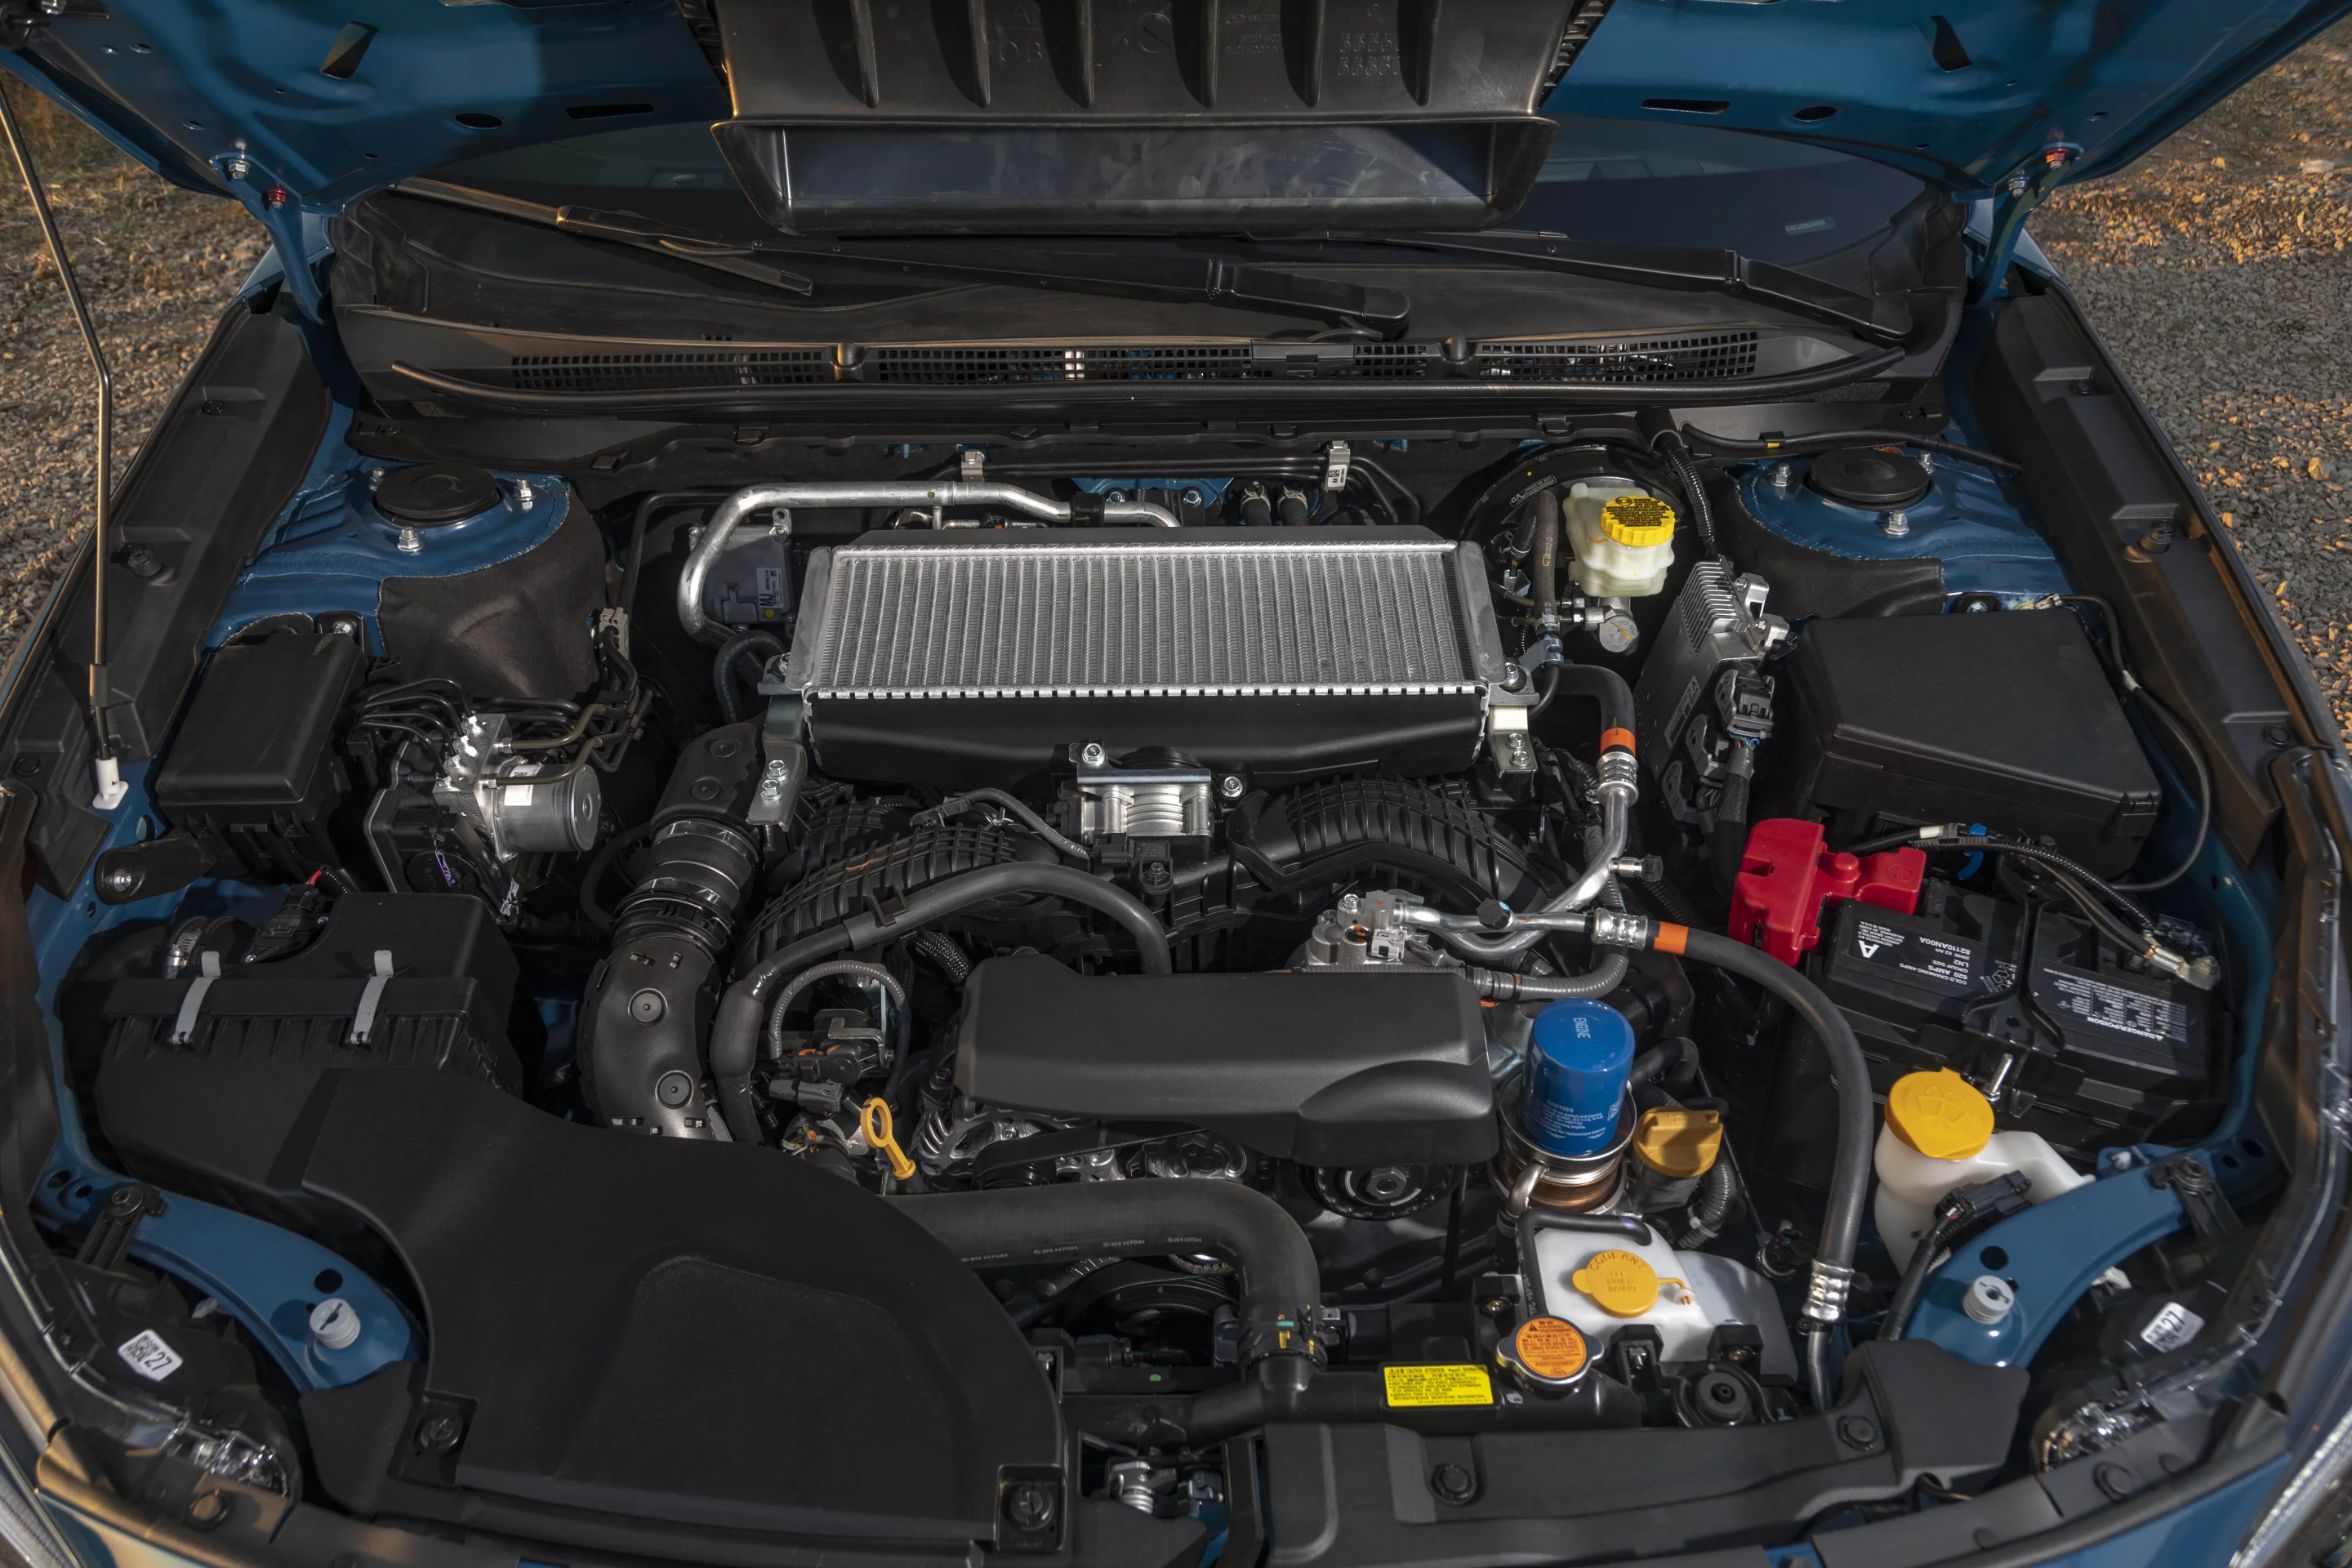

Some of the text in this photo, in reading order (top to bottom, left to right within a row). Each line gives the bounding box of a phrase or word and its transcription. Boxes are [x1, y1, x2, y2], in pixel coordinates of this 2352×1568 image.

[760, 594, 773, 606] MJ
[1918, 937, 1971, 955] 82110AN00A
[1927, 964, 1967, 980] 620 AMPS
[1946, 964, 1968, 973] GROUP
[1953, 959, 1969, 968] LN2
[1899, 963, 1967, 985] COLD CRANKING AMPS
[1574, 1018, 1591, 1038] ENGINE
[1547, 1099, 1574, 1112] CAUTION
[2162, 1310, 2185, 1334] 27
[145, 1352, 172, 1371] 27
